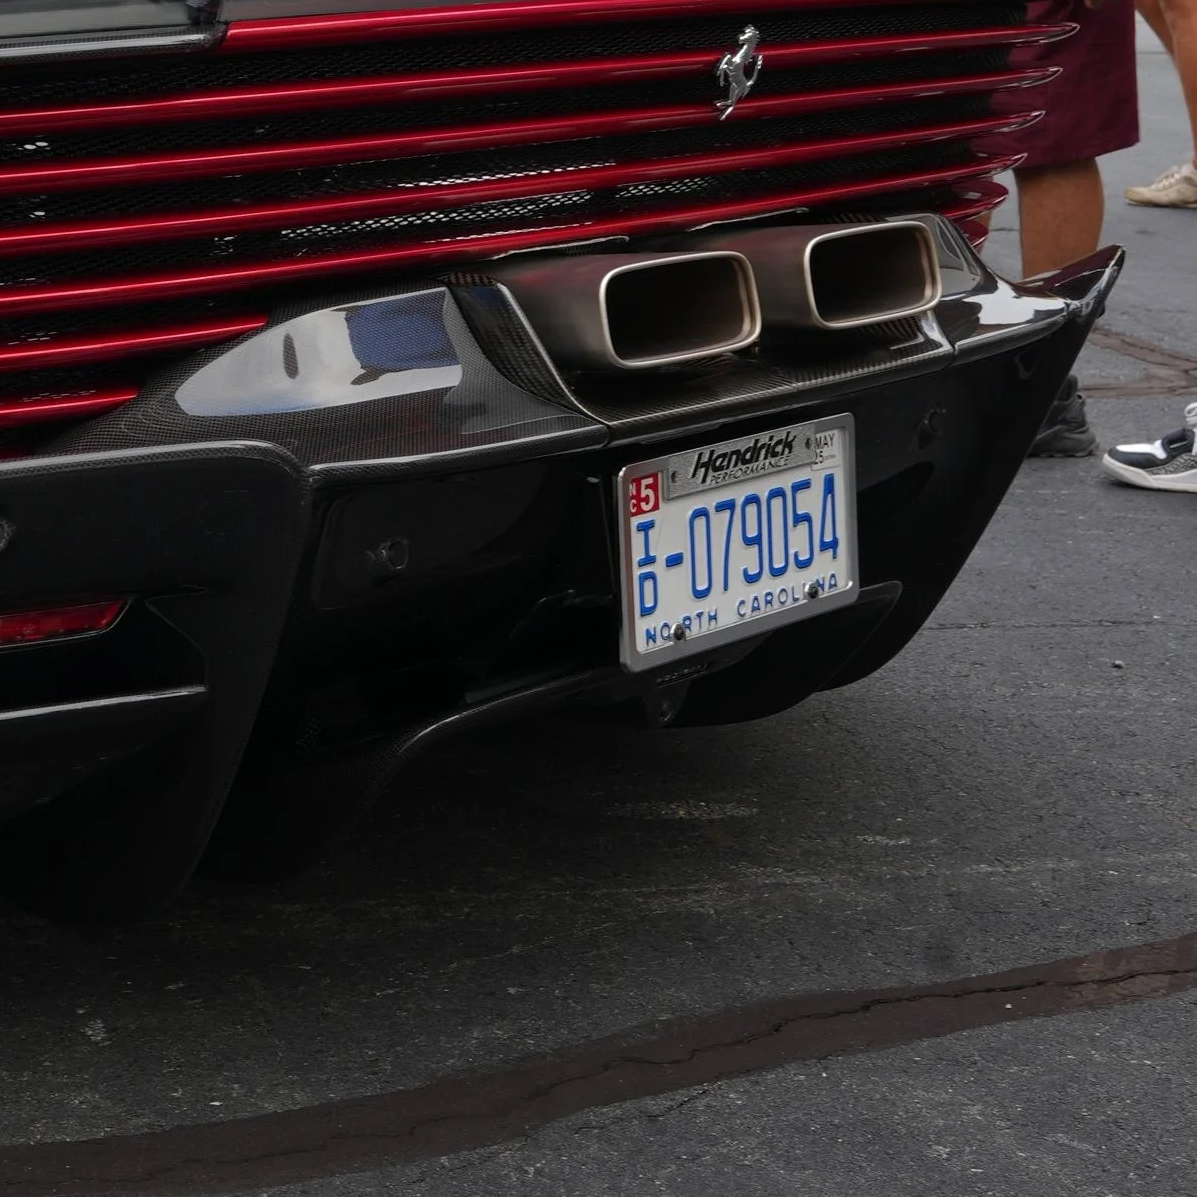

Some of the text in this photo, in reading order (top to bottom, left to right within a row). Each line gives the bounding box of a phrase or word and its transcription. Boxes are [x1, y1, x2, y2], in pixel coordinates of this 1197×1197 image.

[690, 431, 798, 484] Hendrick
[815, 433, 836, 450] MAY
[709, 455, 792, 485] PERFORMANCE
[640, 477, 656, 512] 5
[645, 572, 839, 647] NORTH CAROLNA
